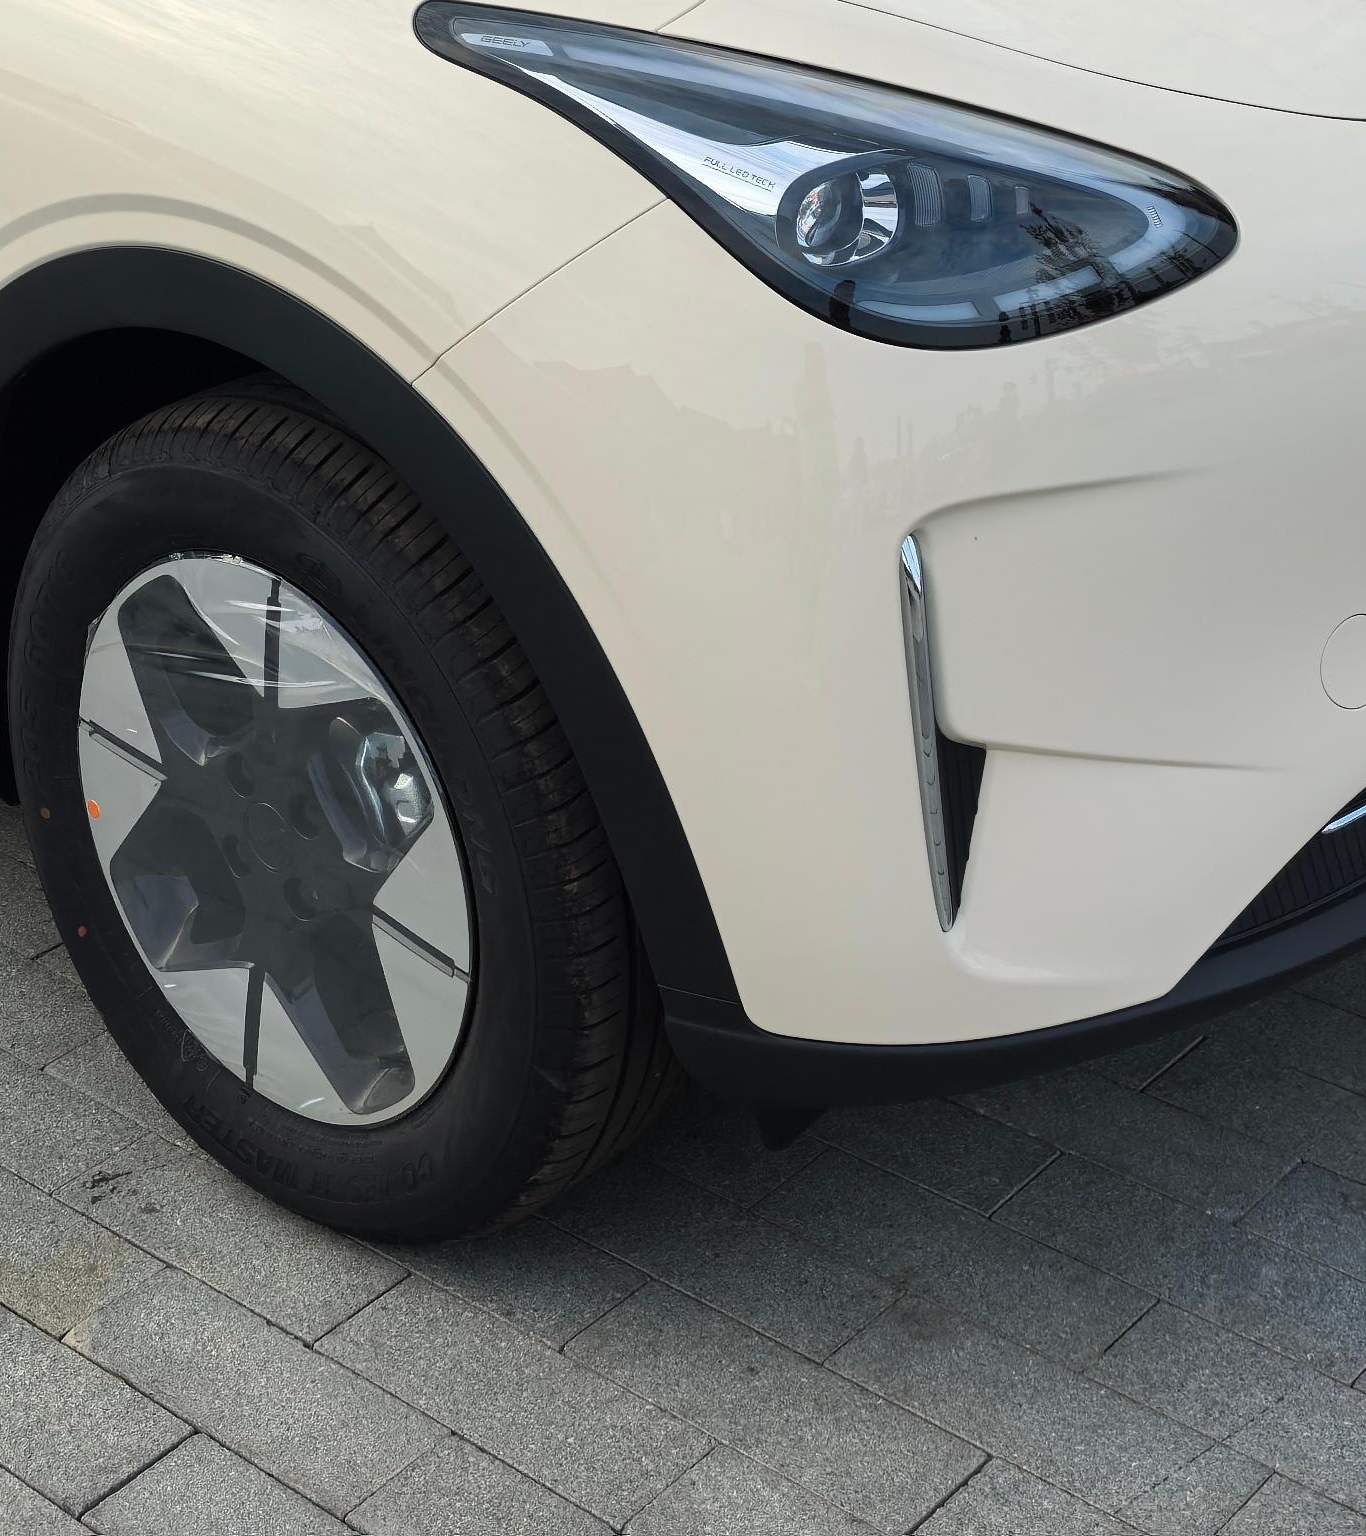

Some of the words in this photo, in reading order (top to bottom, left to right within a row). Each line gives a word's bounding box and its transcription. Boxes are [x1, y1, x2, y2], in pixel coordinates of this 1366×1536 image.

[481, 35, 532, 48] GEELY
[703, 156, 728, 171] FULL
[729, 165, 751, 179] LED
[751, 173, 777, 190] TECH
